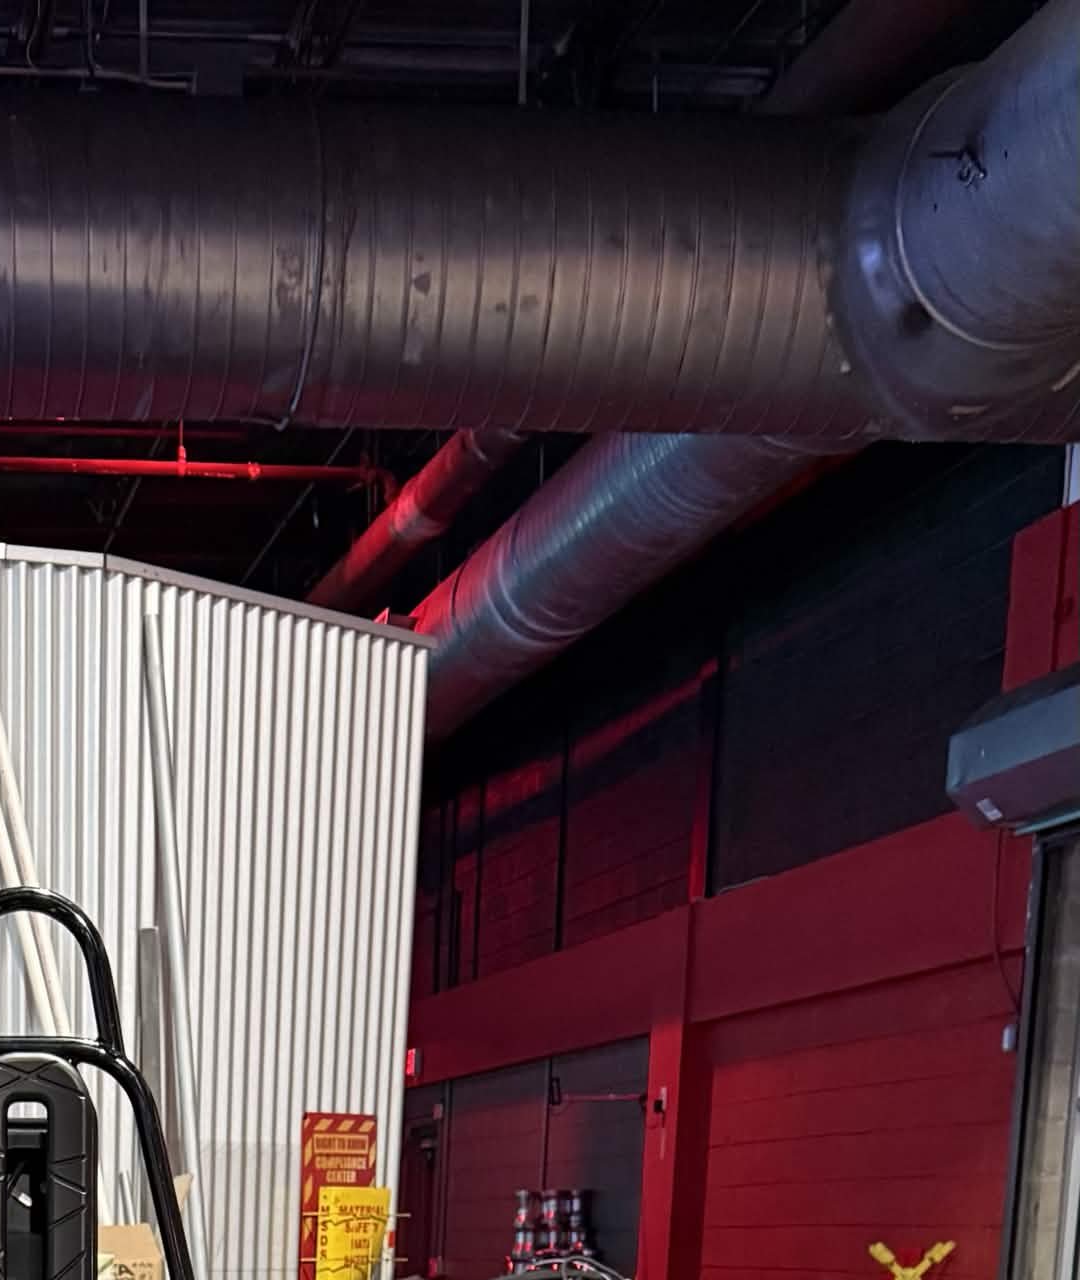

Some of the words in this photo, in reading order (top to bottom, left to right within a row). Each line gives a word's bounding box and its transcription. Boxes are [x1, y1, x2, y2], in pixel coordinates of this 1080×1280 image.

[315, 1155, 367, 1169] COMPLIANCE
[326, 1170, 357, 1183] CENTER
[339, 1205, 384, 1216] MATERIAL
